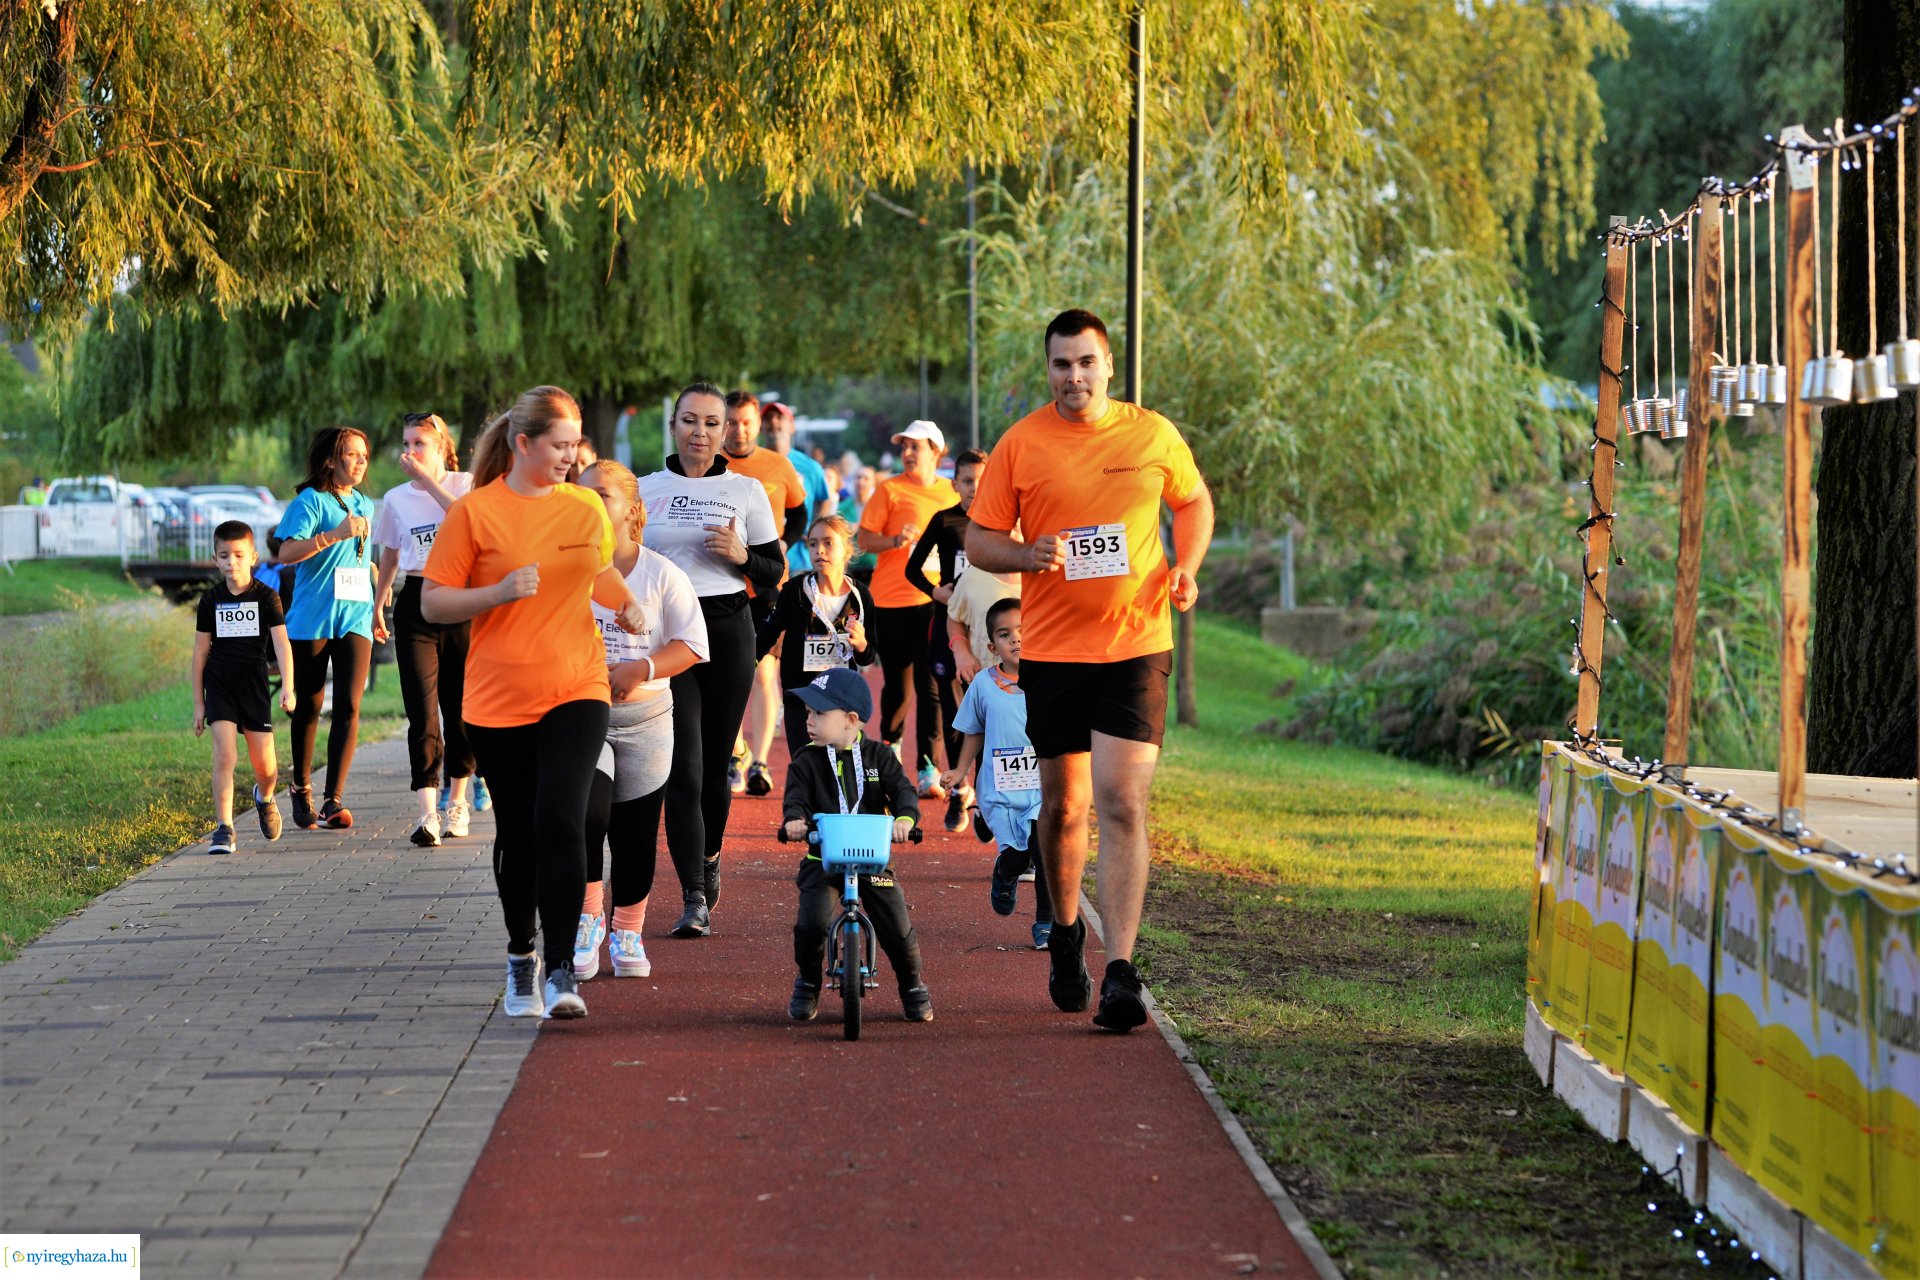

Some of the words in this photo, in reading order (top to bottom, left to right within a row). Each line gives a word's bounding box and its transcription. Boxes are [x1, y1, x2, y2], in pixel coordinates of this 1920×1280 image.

[690, 499, 737, 511] Electrolux
[1068, 535, 1120, 557] 1593
[340, 574, 365, 586] 1418
[218, 610, 256, 622] 1800
[1000, 755, 1038, 772] 1417
